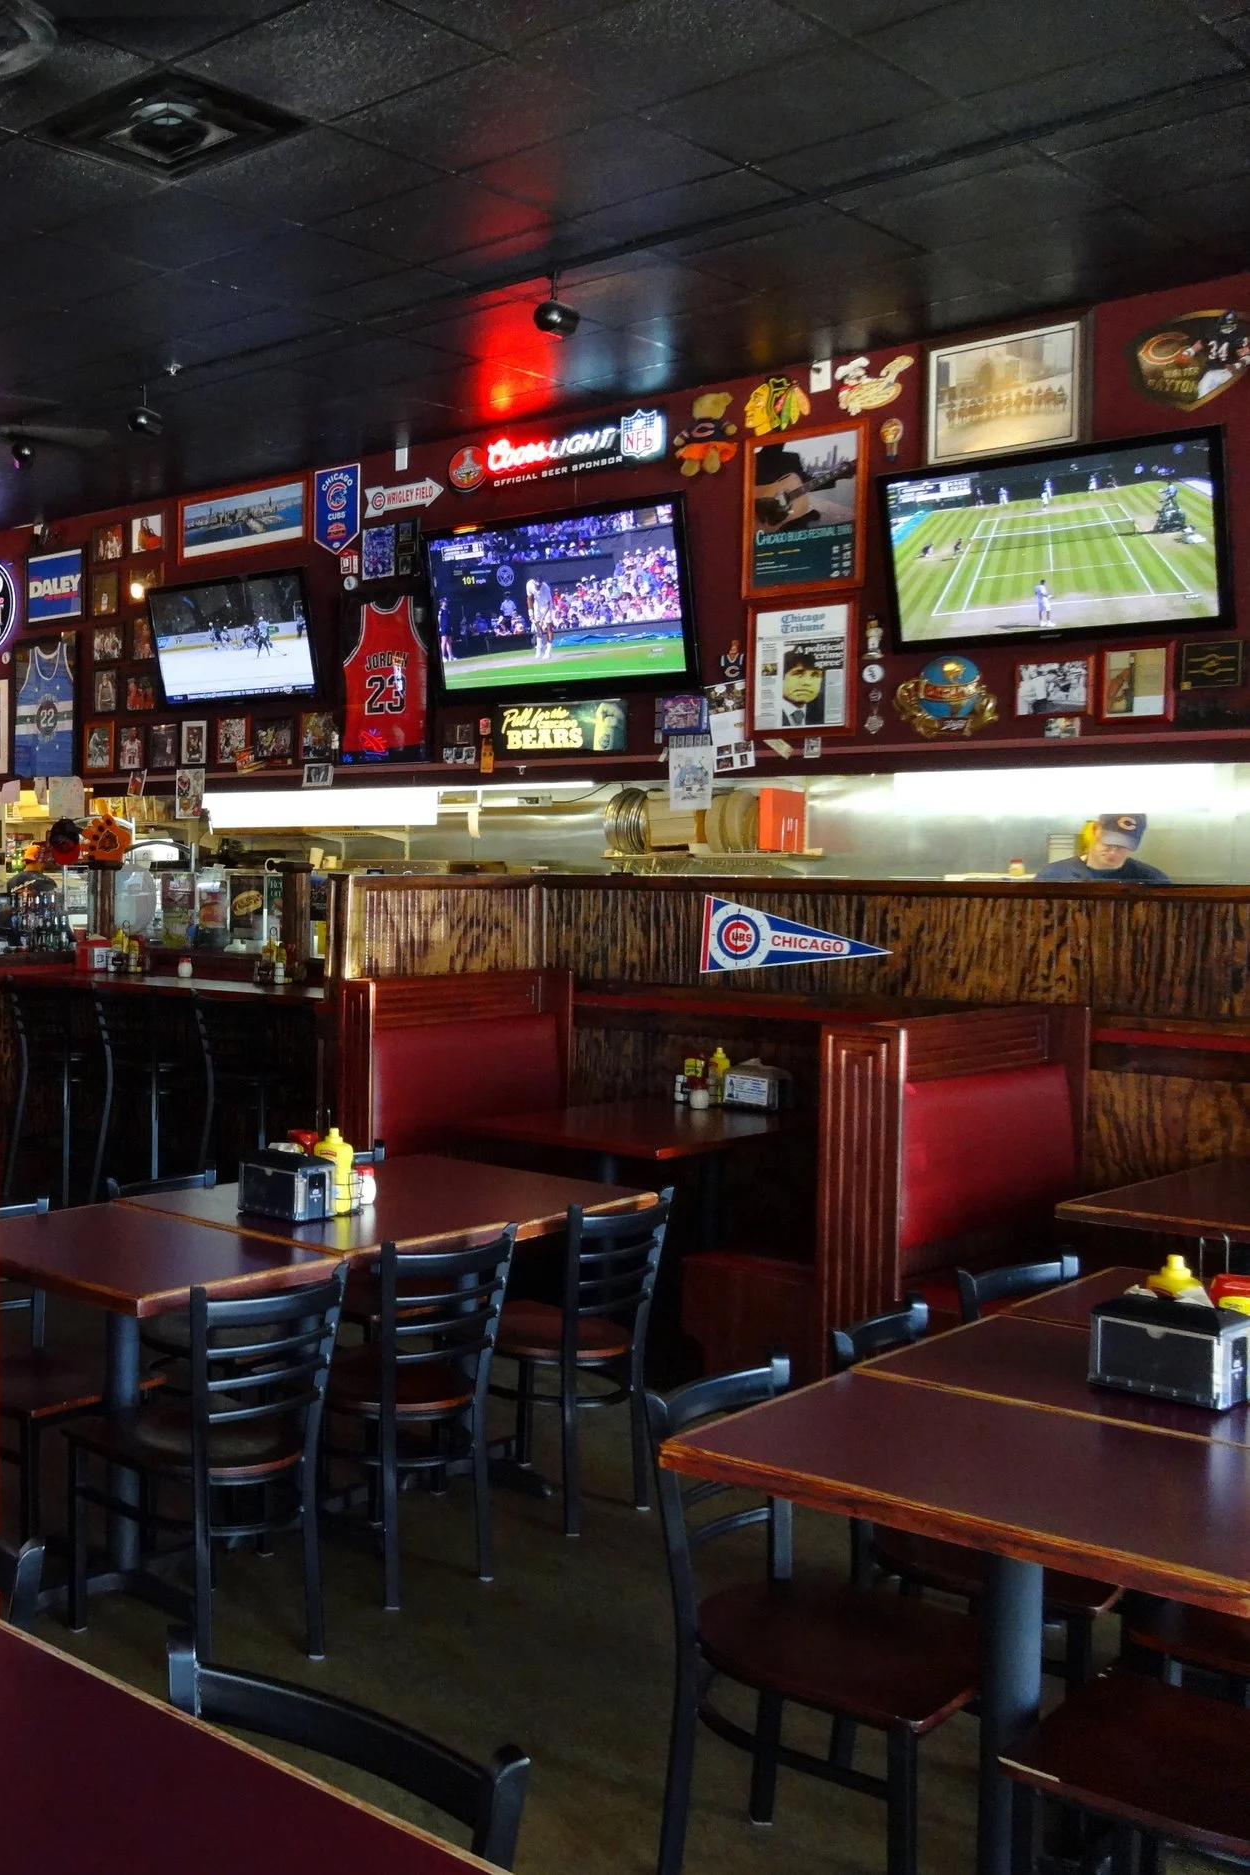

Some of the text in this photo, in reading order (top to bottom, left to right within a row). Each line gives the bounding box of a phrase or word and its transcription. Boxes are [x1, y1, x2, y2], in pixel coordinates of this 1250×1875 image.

[1208, 341, 1229, 361] 34
[626, 430, 654, 451] NFL
[494, 455, 623, 487] OFFICIAL BEER SPONSOR
[321, 473, 353, 491] CHICAGO
[387, 486, 434, 505] WRIGLEY FIELD
[327, 512, 346, 521] CUBS
[29, 574, 81, 598] DALEY
[462, 576, 475, 585] 101
[781, 612, 826, 624] Chicago
[781, 623, 825, 634] Tribune
[795, 641, 844, 655] A political
[365, 651, 409, 672] JORDAN
[365, 674, 406, 715] 23
[41, 709, 54, 727] 22
[506, 728, 584, 749] BEARS
[771, 934, 844, 953] CHICAGO
